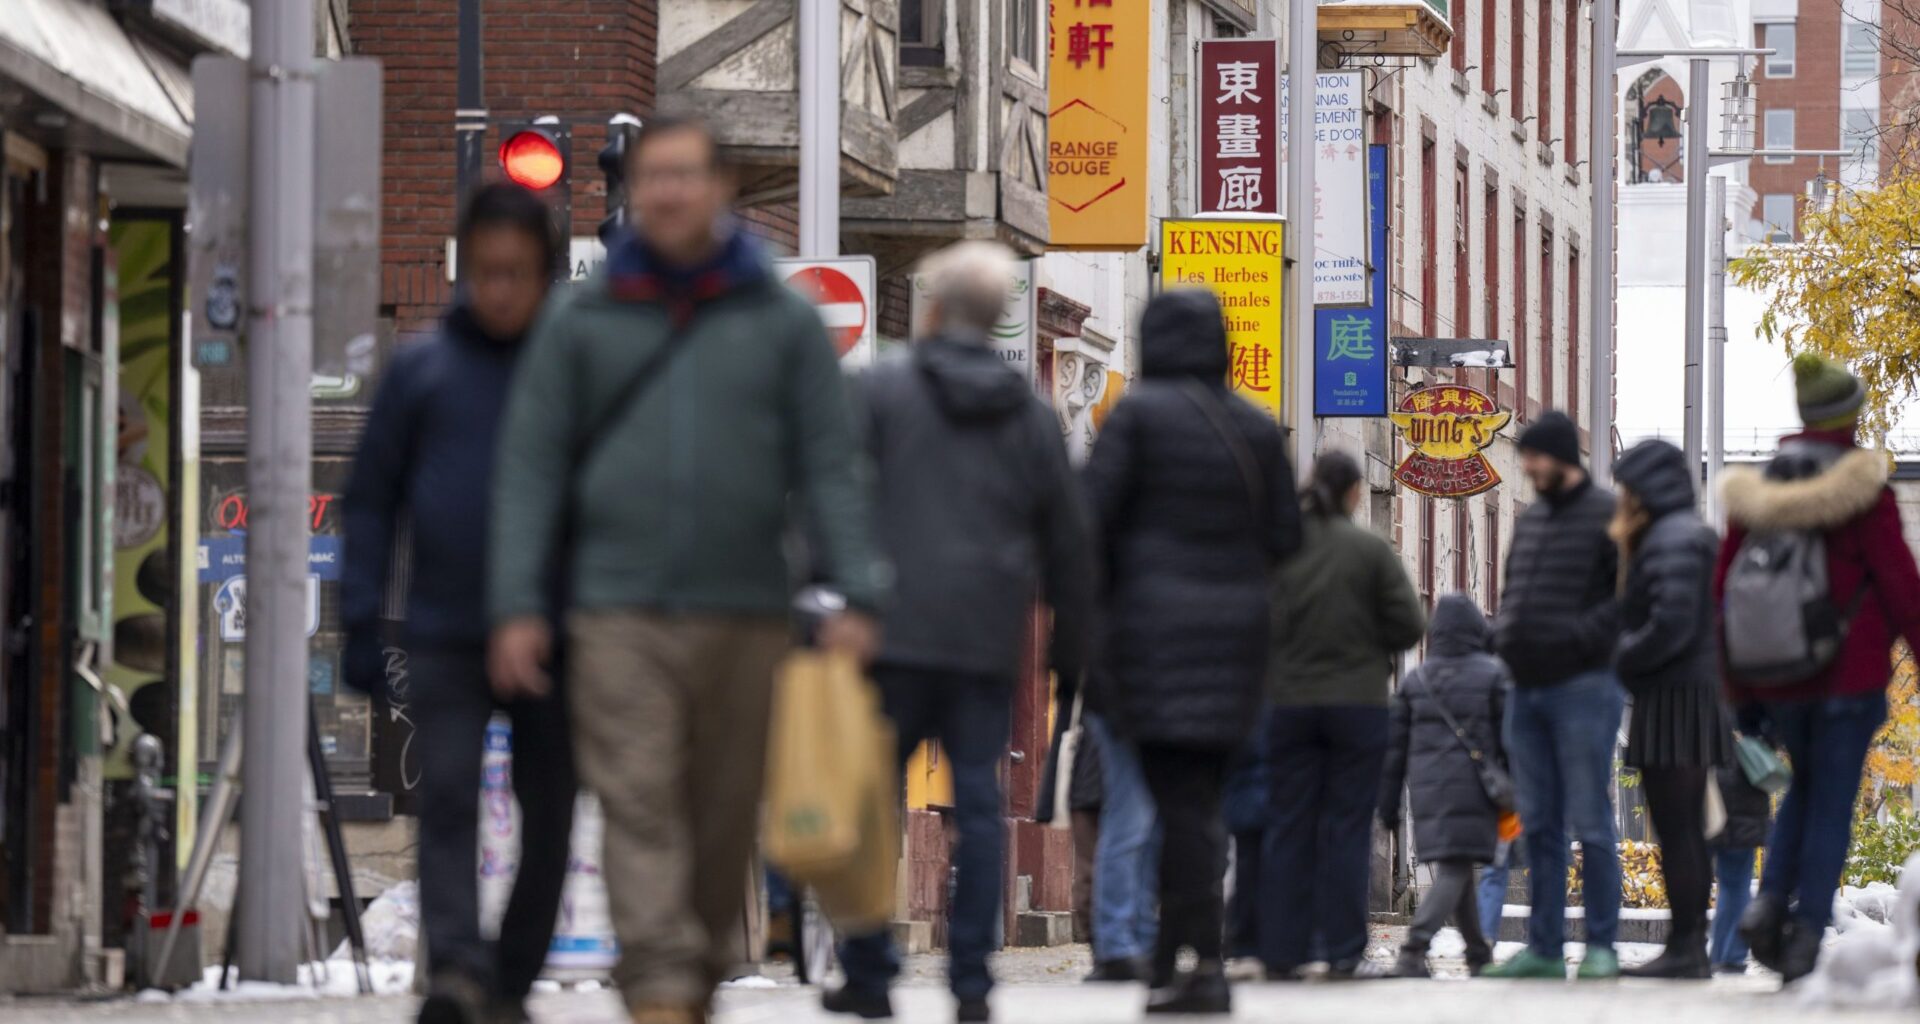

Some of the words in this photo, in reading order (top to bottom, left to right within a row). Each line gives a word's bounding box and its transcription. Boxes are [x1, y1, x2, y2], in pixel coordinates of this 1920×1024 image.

[1050, 141, 1118, 156] RANGE
[1169, 230, 1278, 255] KENSING
[1177, 267, 1205, 283] Les
[1214, 267, 1268, 282] Herbes
[1218, 292, 1270, 307] inales
[1224, 316, 1260, 331] hine
[1327, 314, 1374, 361] 庭
[308, 553, 335, 563] ABAC
